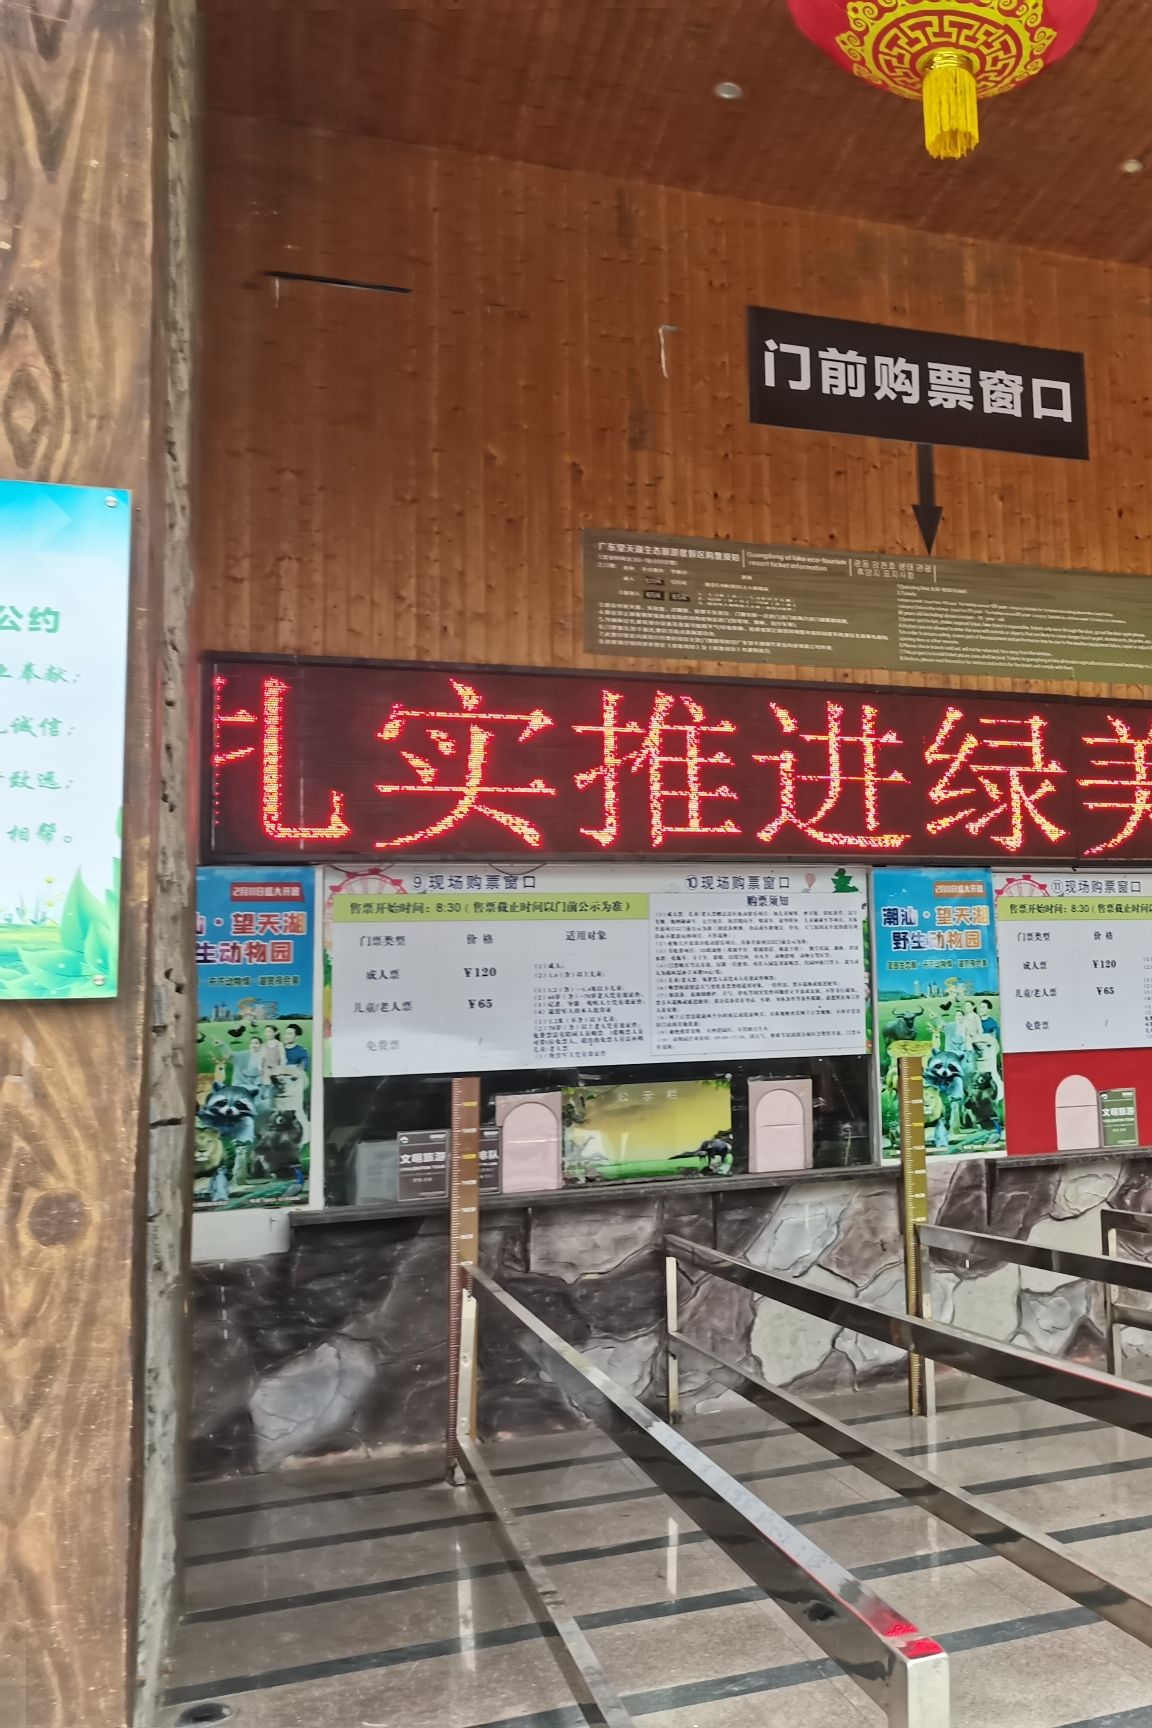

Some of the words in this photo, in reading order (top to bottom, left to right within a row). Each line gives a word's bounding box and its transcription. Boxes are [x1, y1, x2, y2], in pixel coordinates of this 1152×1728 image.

[764, 338, 1072, 423] 门前购票窗口
[0, 605, 60, 633] 公约
[0, 715, 75, 737] 诚信；
[747, 895, 789, 907] 购票须知
[359, 935, 406, 947] 门票类型
[1093, 959, 1117, 969] ¥120
[365, 968, 401, 981] 成人票
[463, 967, 497, 978] ¥120
[1096, 987, 1114, 996] ¥65
[468, 999, 493, 1009] ¥65
